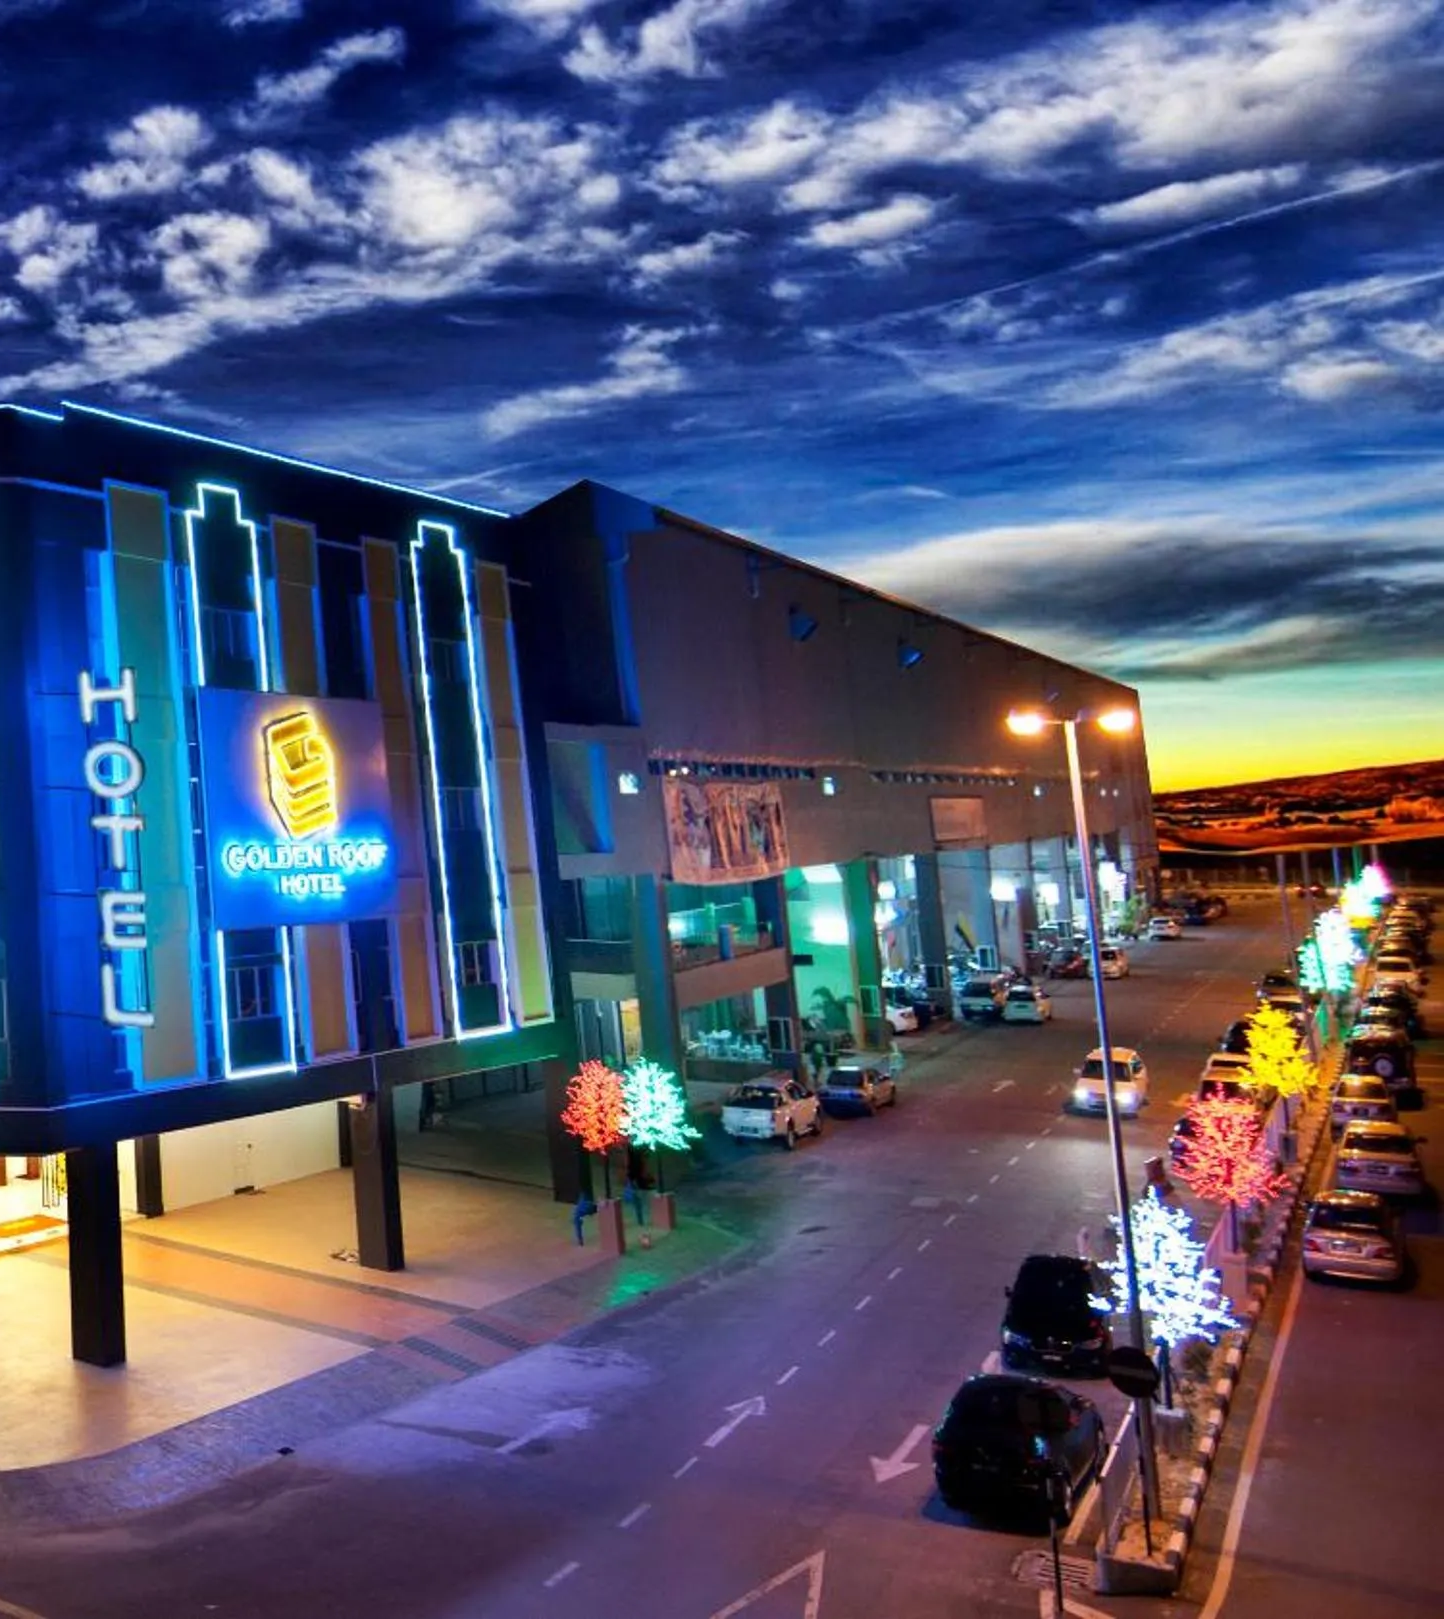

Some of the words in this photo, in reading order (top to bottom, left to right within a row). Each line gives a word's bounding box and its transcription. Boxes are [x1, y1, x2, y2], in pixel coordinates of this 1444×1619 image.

[79, 667, 154, 1028] HOTEL
[225, 842, 323, 873] GOLDEN
[328, 841, 387, 871] ROOF
[279, 873, 346, 894] HOTEL
